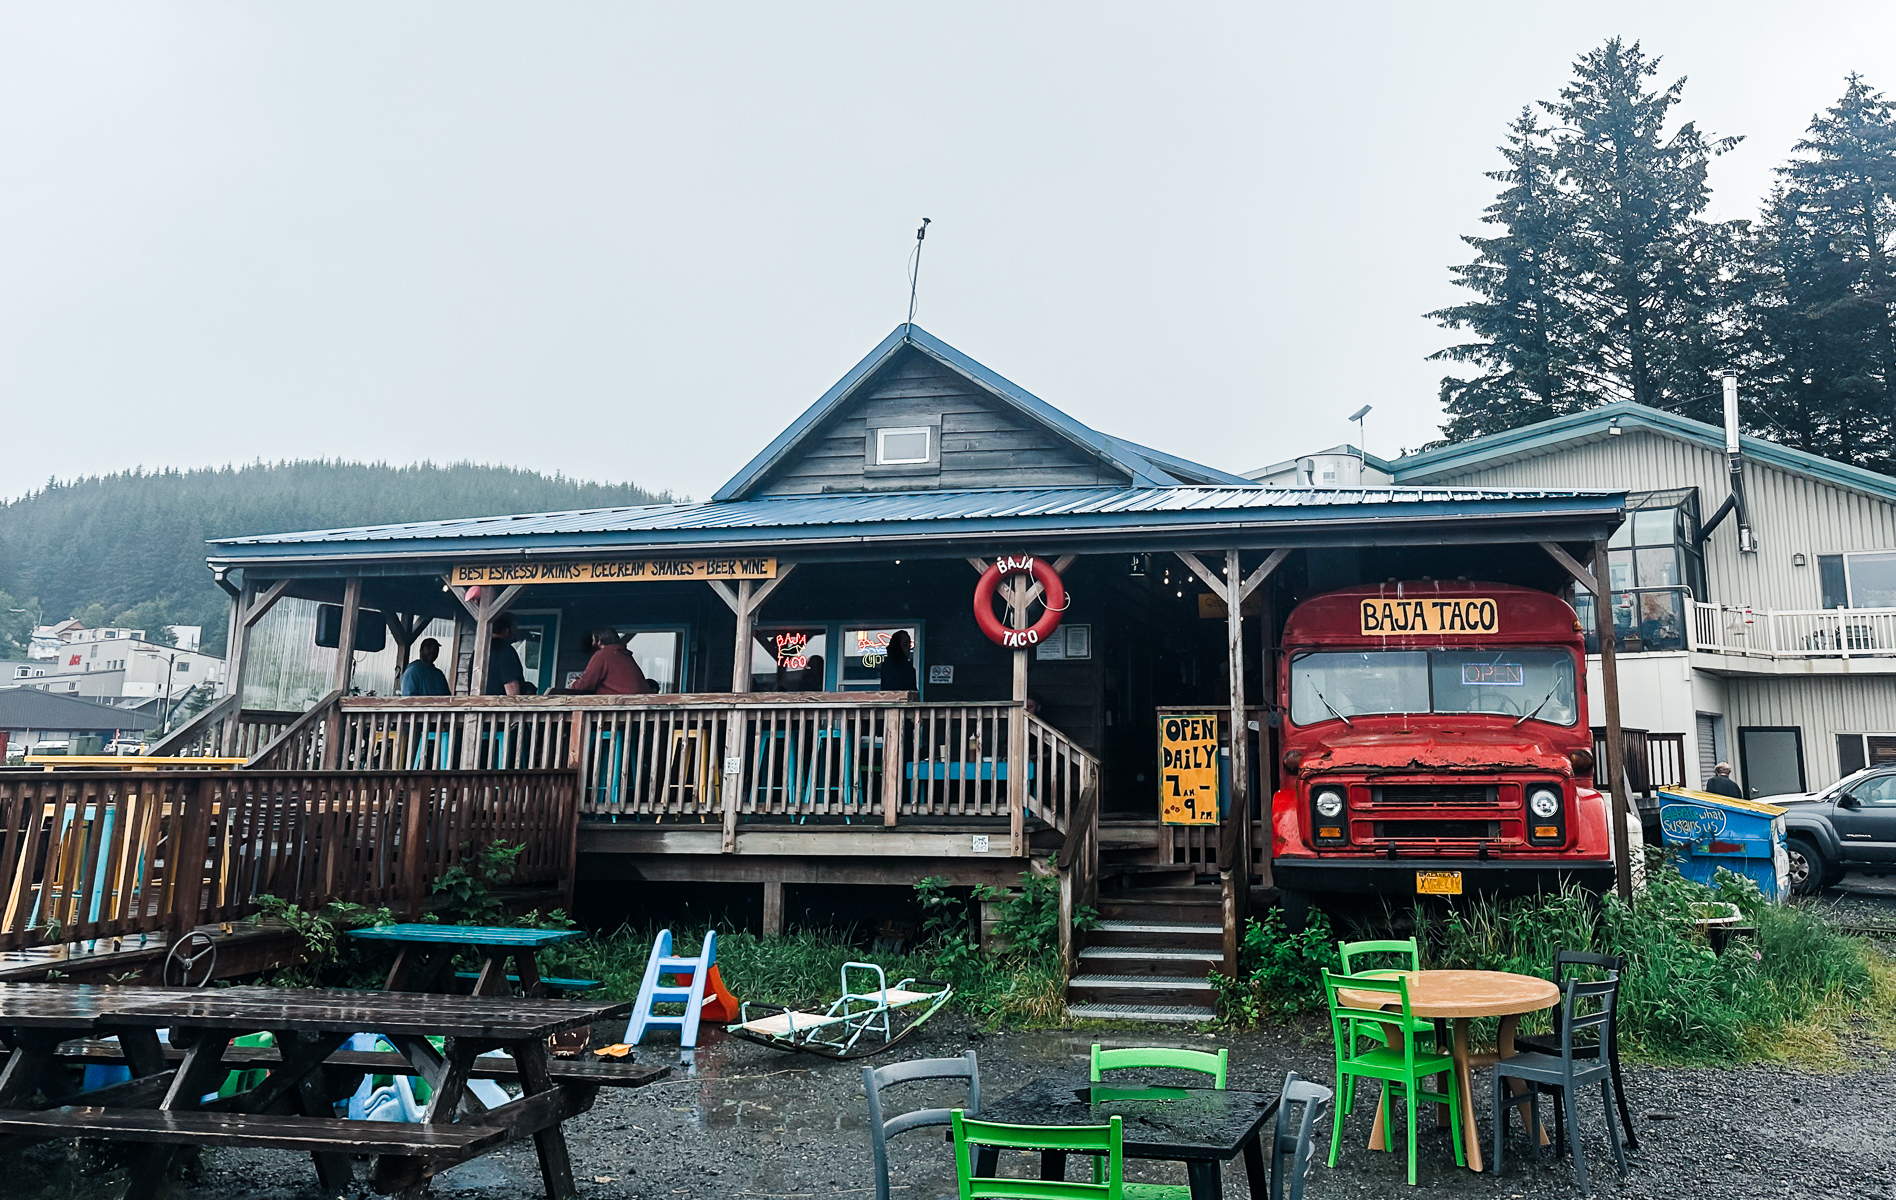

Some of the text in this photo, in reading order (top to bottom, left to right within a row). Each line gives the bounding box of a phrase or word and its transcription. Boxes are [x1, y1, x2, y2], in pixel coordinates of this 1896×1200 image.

[459, 566, 488, 581] BEST
[488, 564, 539, 580] ESPRESSO
[651, 560, 694, 576] SHAKES
[707, 559, 736, 575] BEER
[738, 558, 768, 575] WINE
[996, 556, 1034, 574] BAJA
[1363, 601, 1495, 631] BAJA TACO
[776, 632, 807, 648] BAJA
[1003, 630, 1038, 647] TACO
[777, 655, 807, 669] TACO
[1465, 665, 1520, 682] OPEN
[1166, 719, 1215, 742] OPEN
[1184, 798, 1196, 819] 9
[1699, 808, 1724, 821] what
